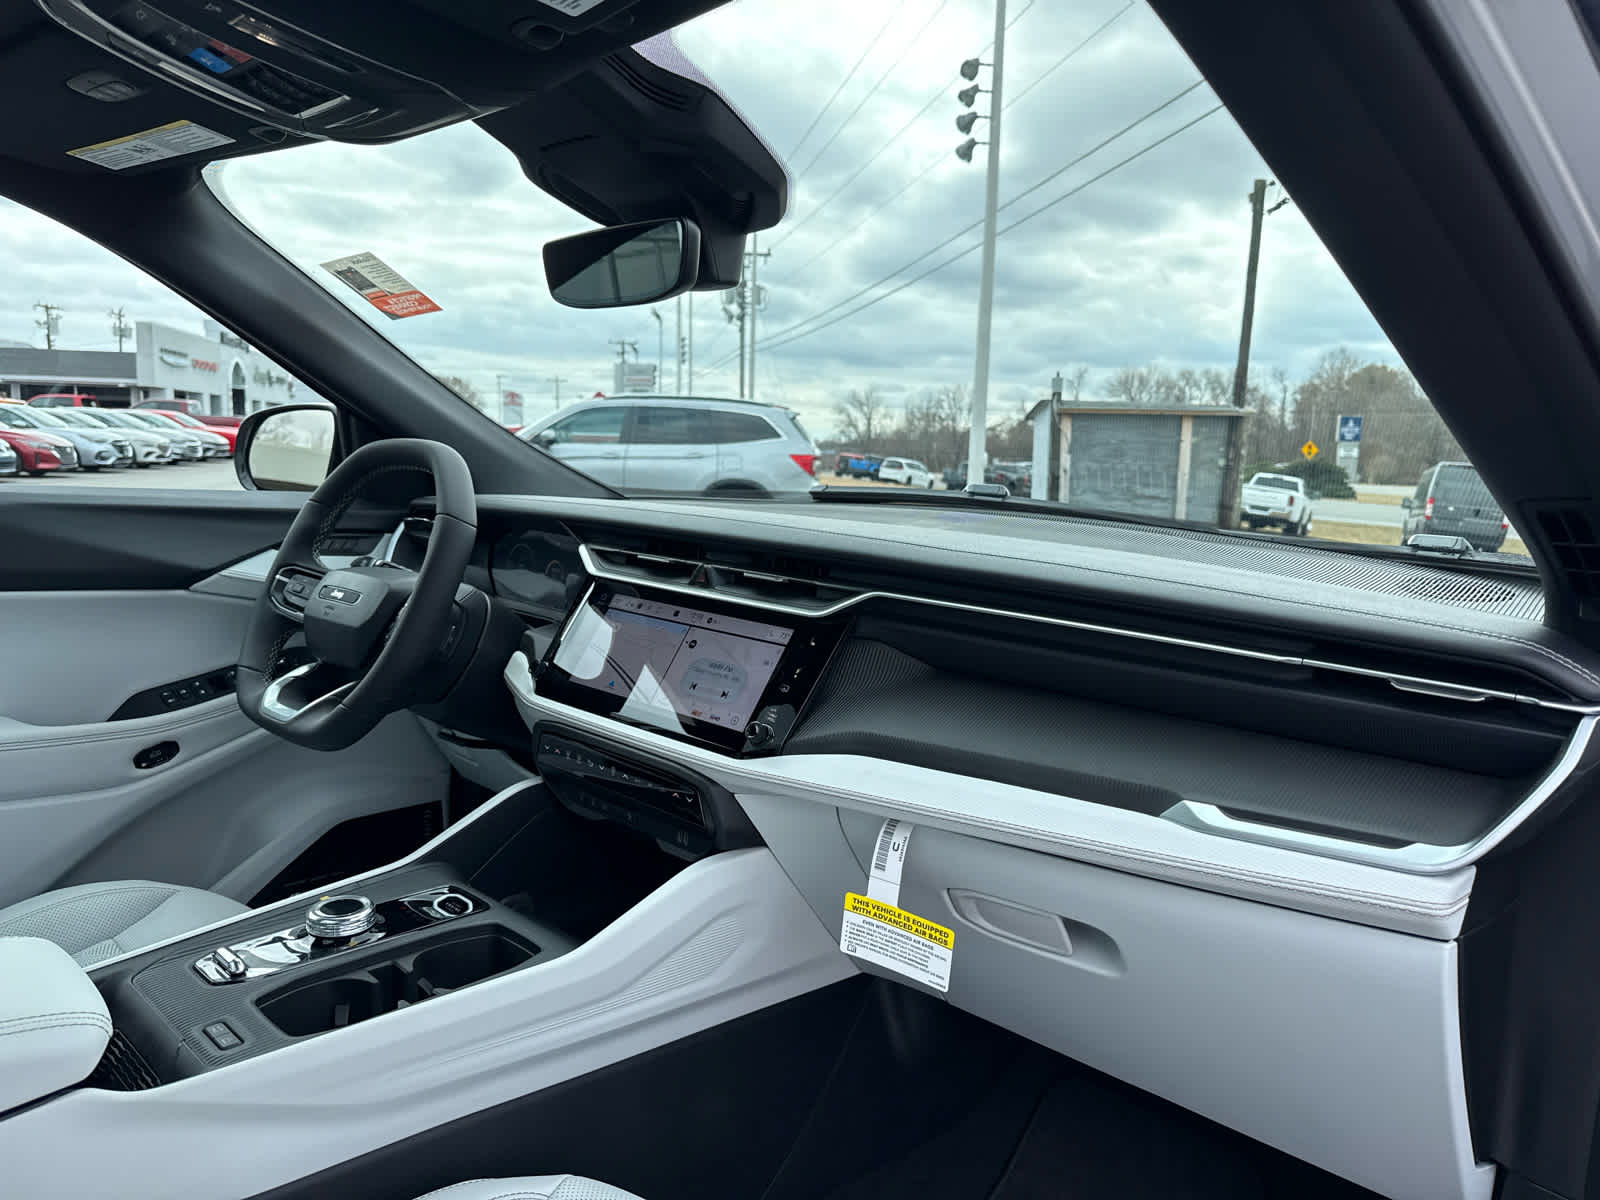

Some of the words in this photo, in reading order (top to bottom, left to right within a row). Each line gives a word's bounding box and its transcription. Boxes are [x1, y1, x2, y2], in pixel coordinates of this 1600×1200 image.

[852, 905, 871, 915] WITH
[873, 911, 913, 931] ADVANCED
[914, 927, 926, 936] AIR
[928, 932, 948, 945] BAGS
[853, 897, 869, 908] THIS
[872, 903, 902, 919] VEHICLE
[904, 913, 911, 922] IS
[913, 917, 949, 939] EQUIPPED
